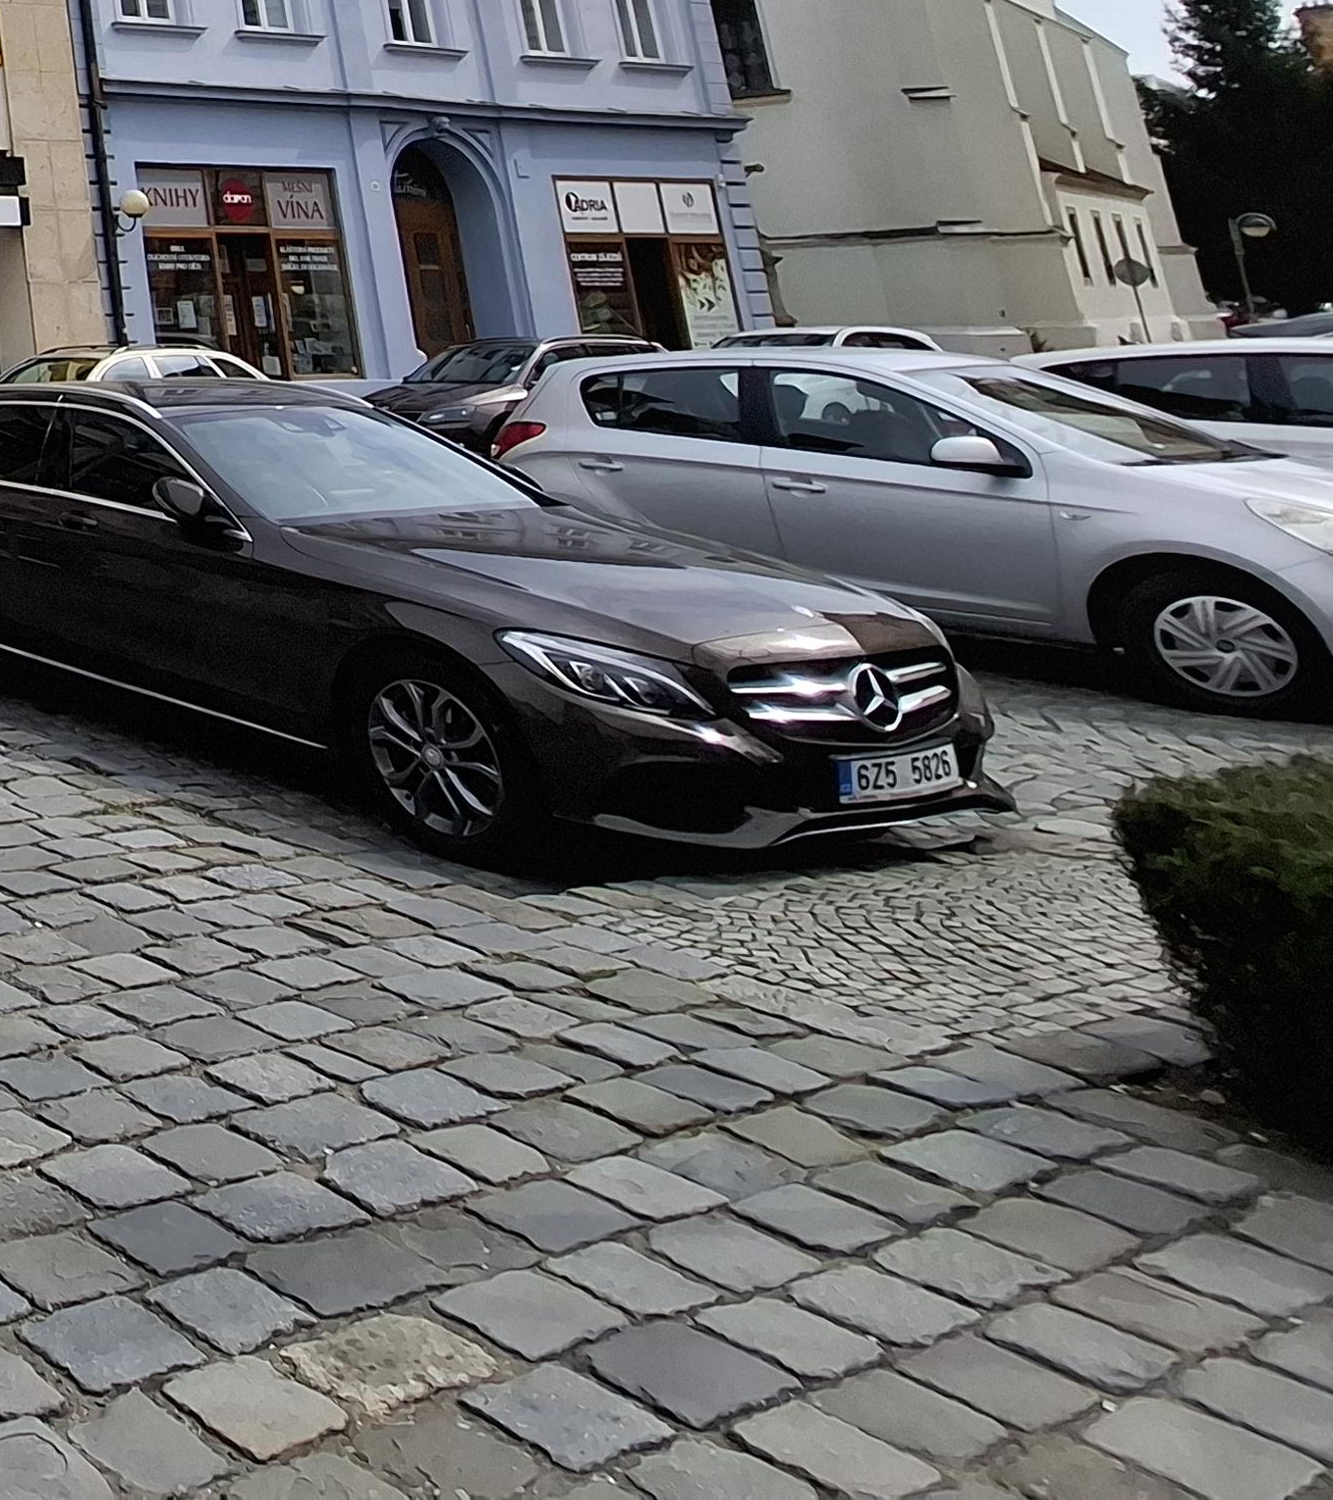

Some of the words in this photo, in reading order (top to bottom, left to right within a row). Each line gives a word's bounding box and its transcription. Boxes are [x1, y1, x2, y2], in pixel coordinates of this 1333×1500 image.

[140, 187, 200, 208] KNIHY
[277, 193, 324, 219] VÍNA
[857, 761, 897, 791] 6Z5
[911, 749, 952, 785] 5826
